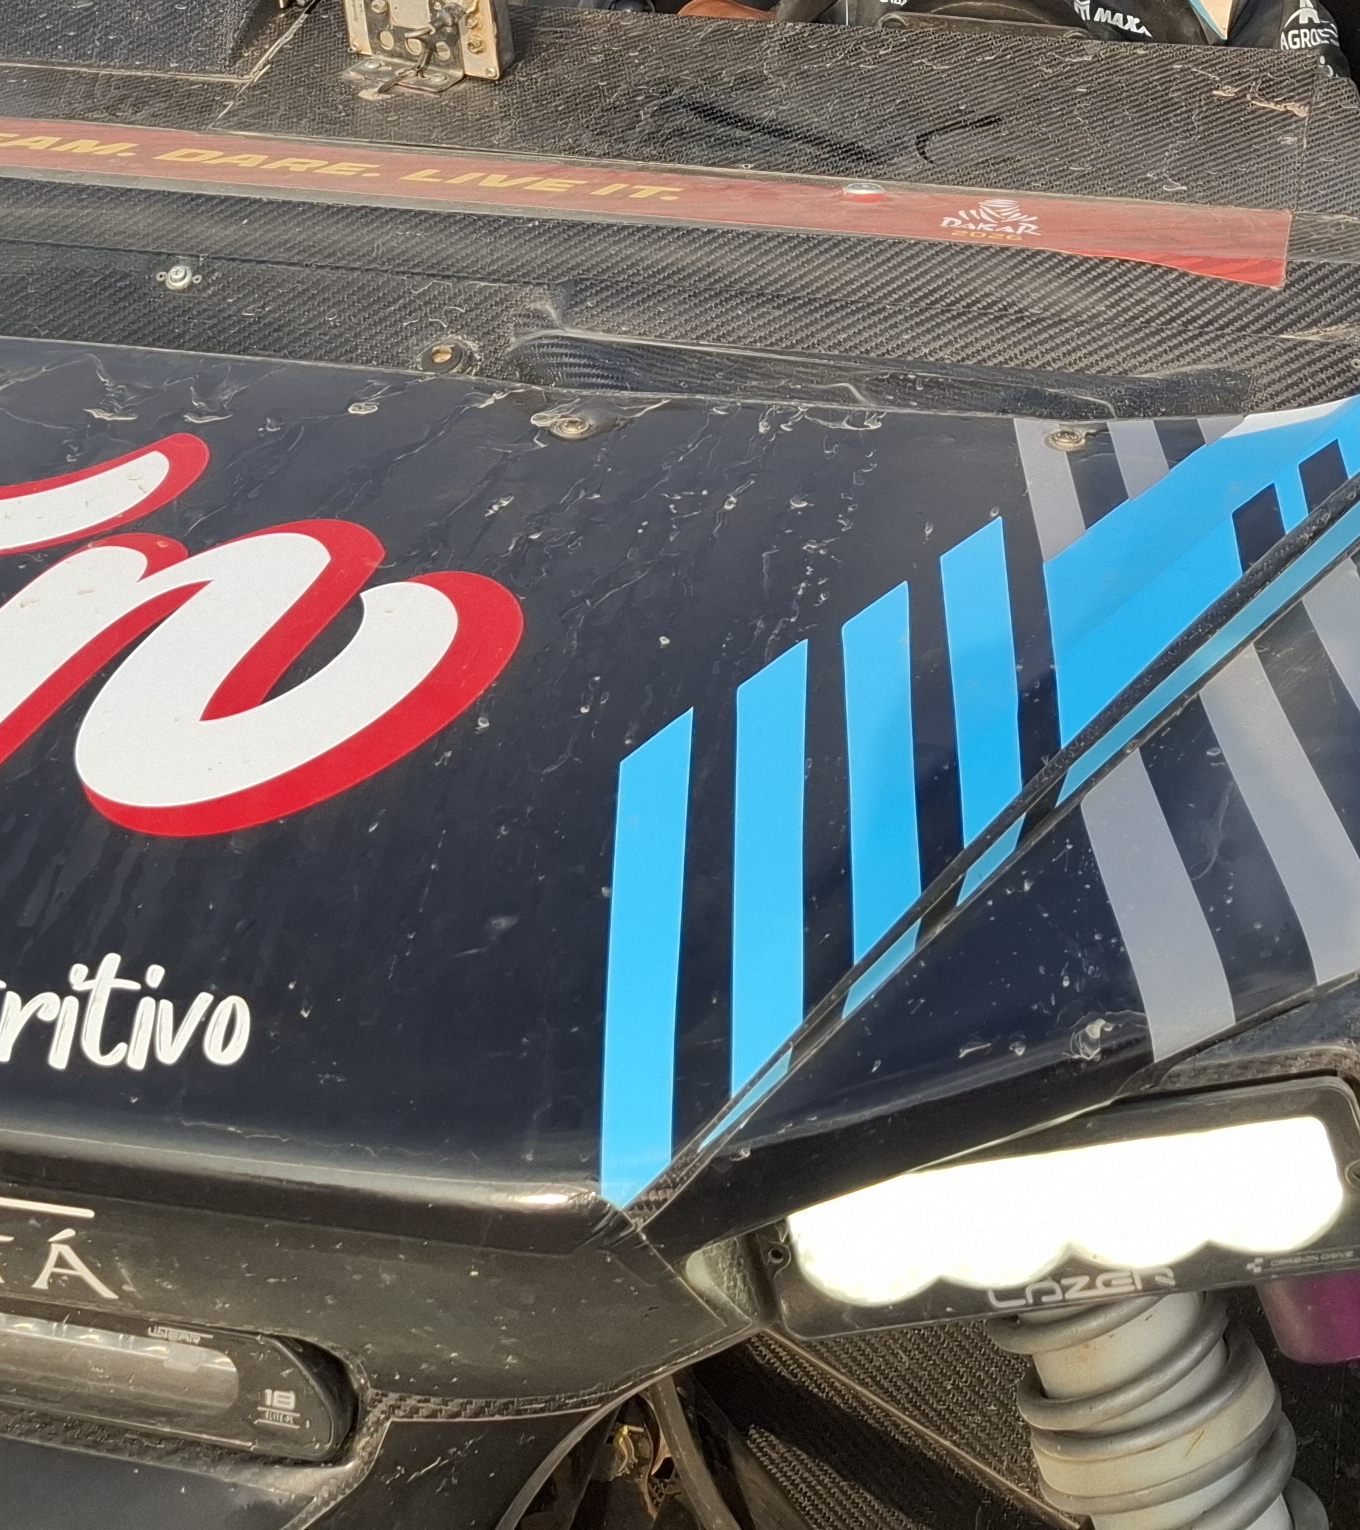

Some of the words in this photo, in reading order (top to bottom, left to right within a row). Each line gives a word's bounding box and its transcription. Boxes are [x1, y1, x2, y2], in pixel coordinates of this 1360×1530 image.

[153, 147, 381, 178] DARE.
[419, 167, 587, 194] LIVE
[606, 181, 686, 202] IT.
[940, 217, 1042, 235] DAKAR
[951, 230, 1022, 240] 2026
[988, 1267, 1175, 1309] LAZER
[265, 1389, 296, 1410] 18
